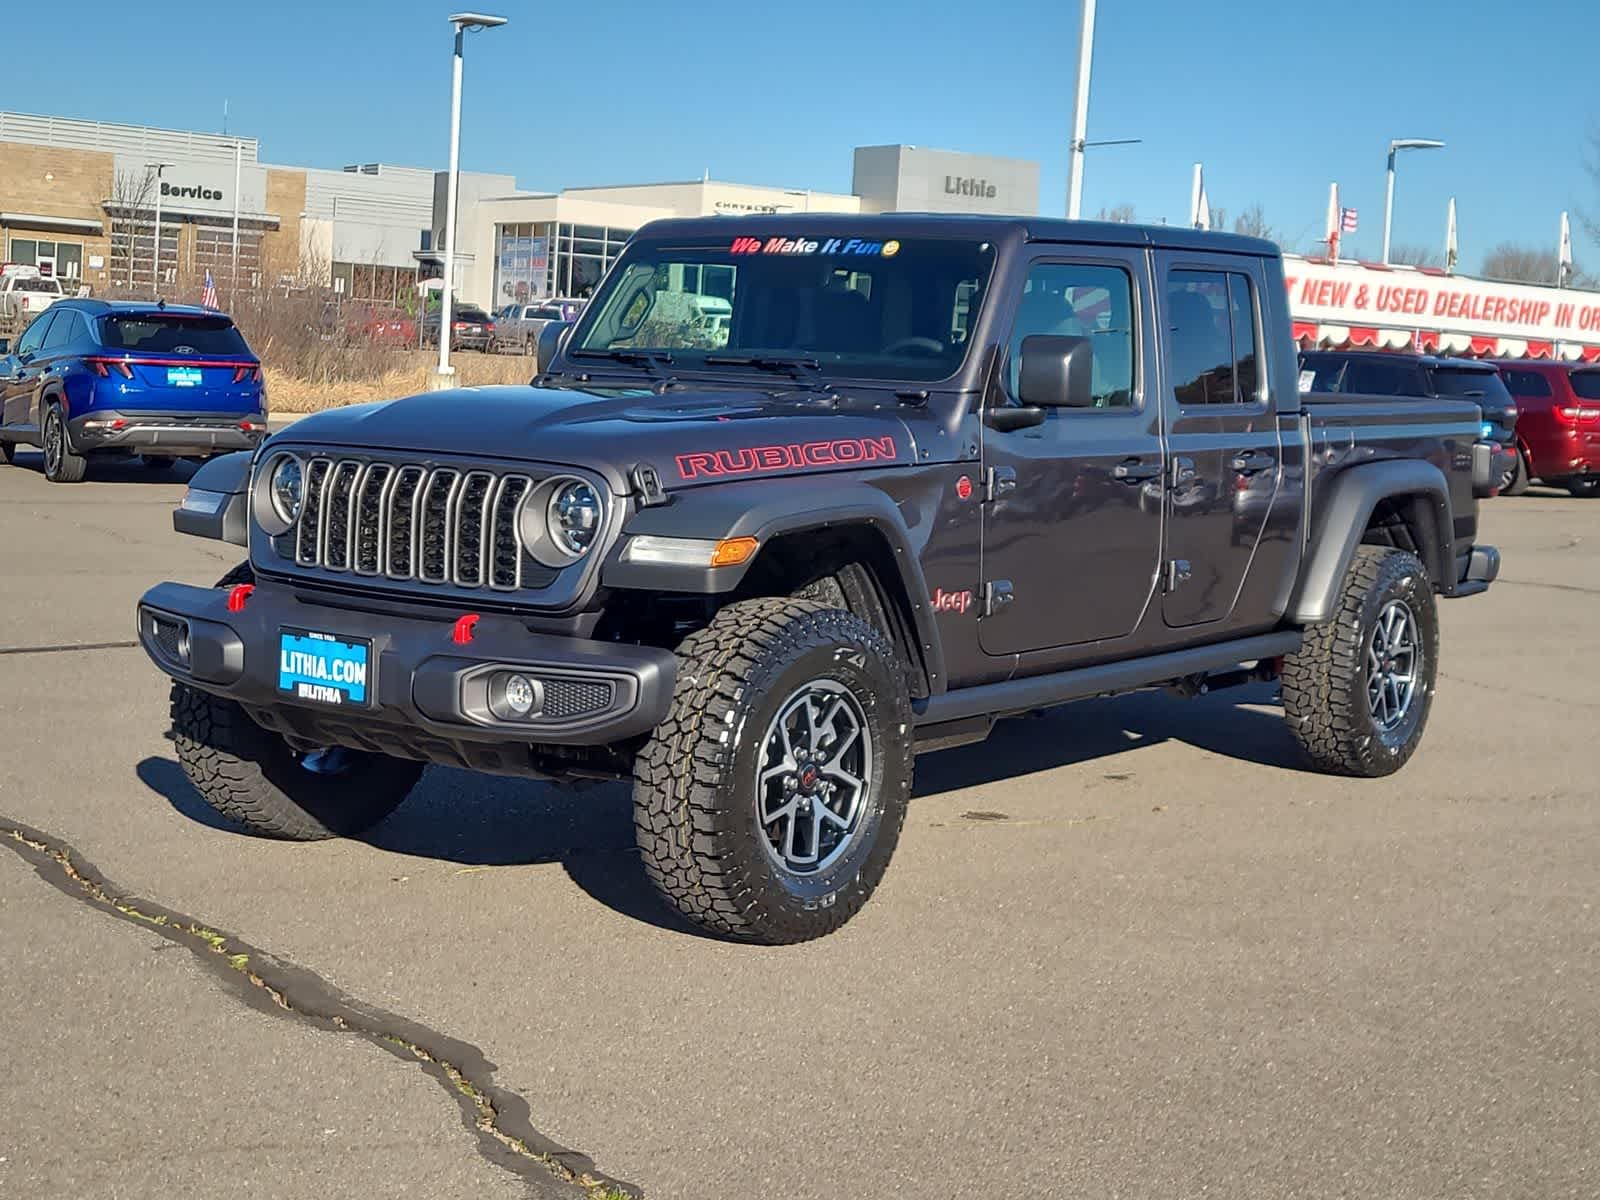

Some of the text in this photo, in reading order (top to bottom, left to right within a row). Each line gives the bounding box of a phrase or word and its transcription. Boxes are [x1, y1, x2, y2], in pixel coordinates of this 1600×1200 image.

[160, 182, 223, 201] Service
[945, 175, 997, 198] Lithia
[731, 237, 882, 255] We Make It Fun
[1300, 278, 1351, 308] NEW
[1354, 283, 1370, 310] &
[1375, 285, 1430, 315] USED
[1432, 290, 1552, 326] DEALERSHIP
[1554, 302, 1576, 329] IN
[675, 436, 897, 480] RUBICON
[930, 586, 972, 615] Jeep
[281, 649, 367, 687] LITHIA.COM
